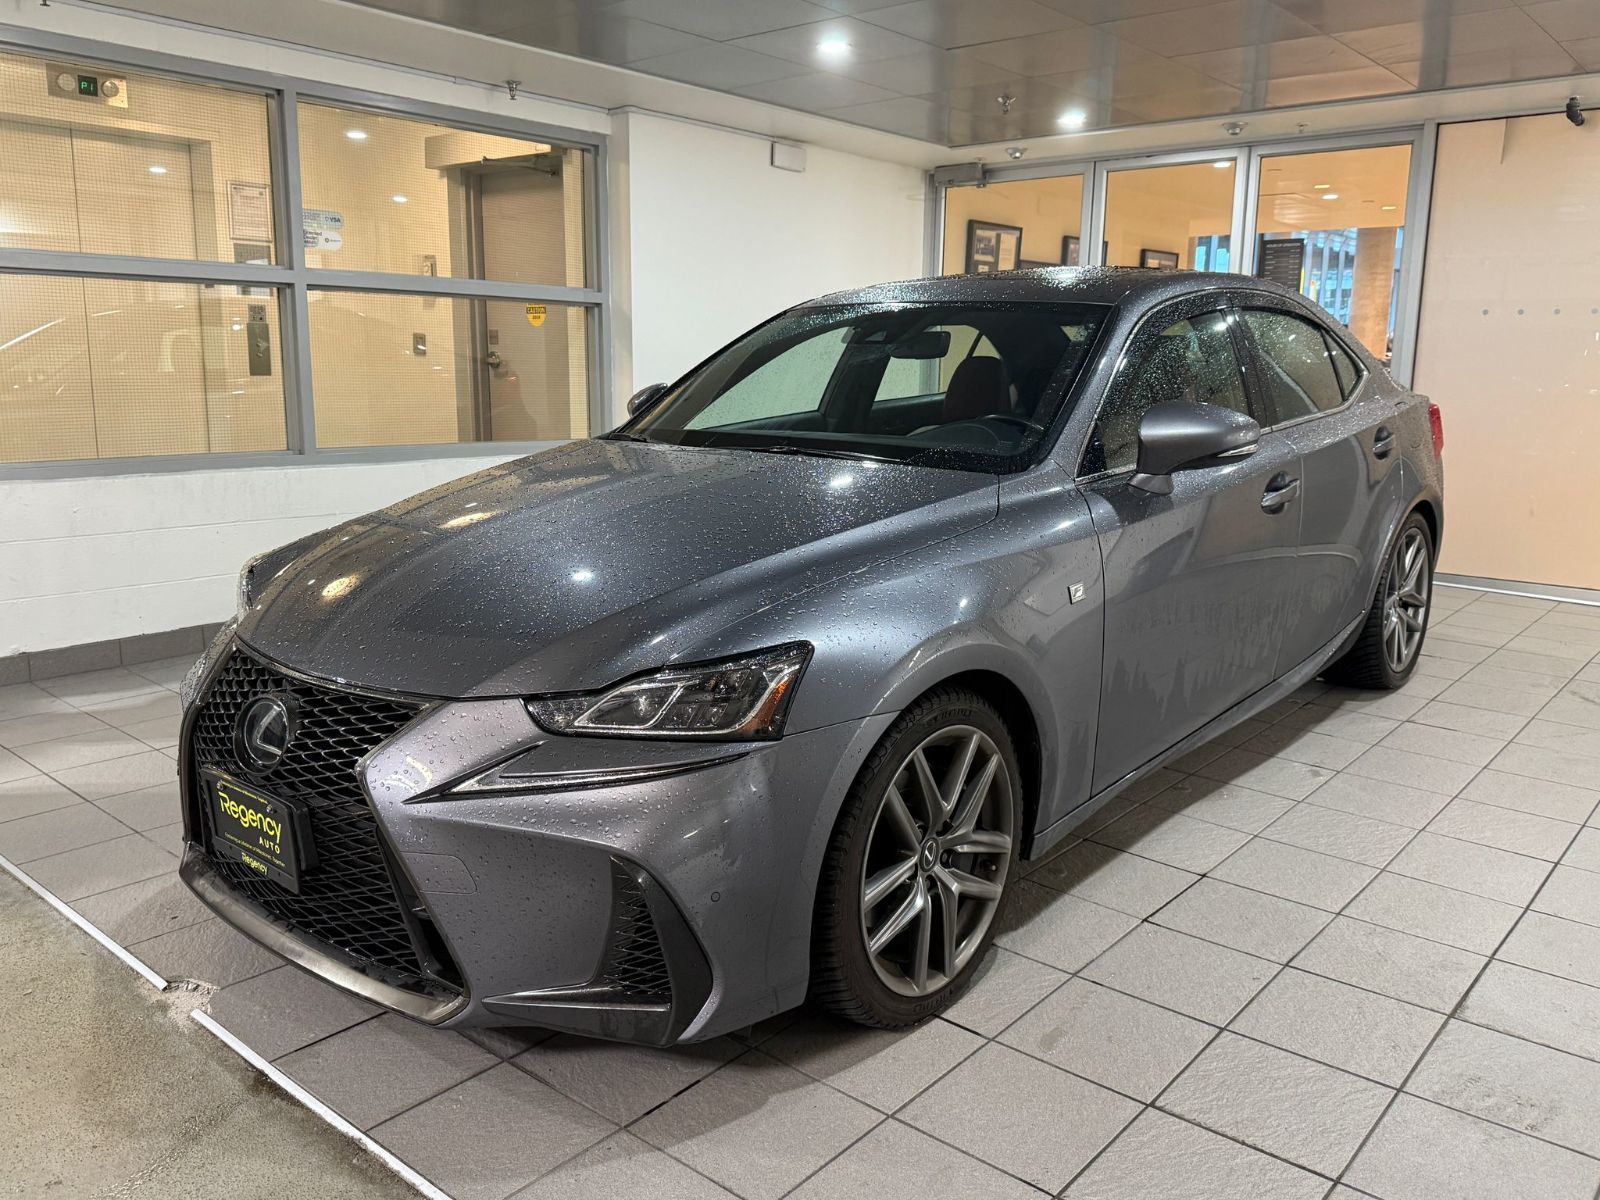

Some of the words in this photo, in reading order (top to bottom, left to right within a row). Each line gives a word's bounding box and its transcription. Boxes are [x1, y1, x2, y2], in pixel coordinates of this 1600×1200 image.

[218, 791, 282, 844] Regency
[259, 836, 281, 855] AUTO
[241, 852, 268, 876] Regency
